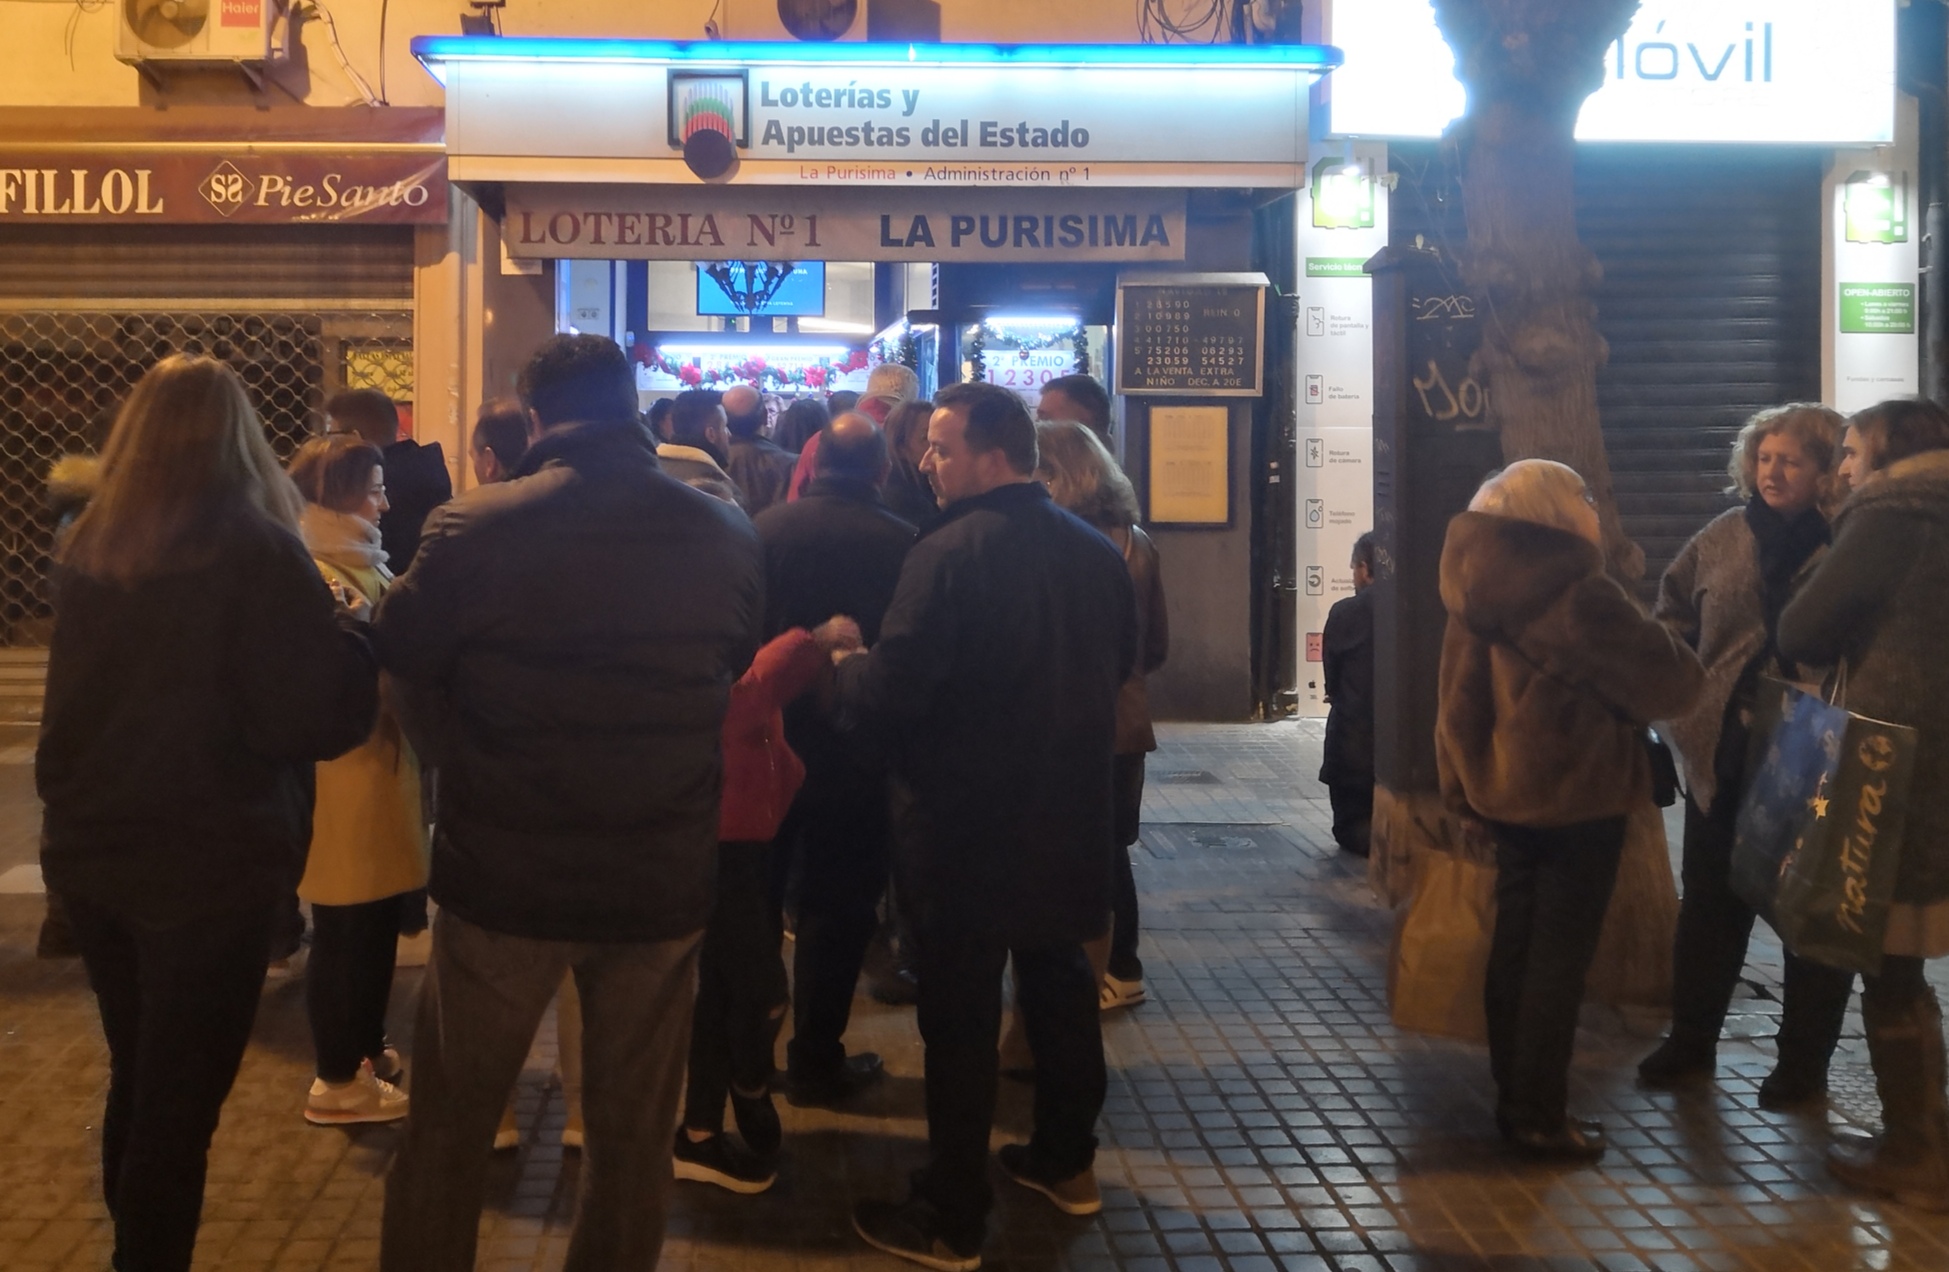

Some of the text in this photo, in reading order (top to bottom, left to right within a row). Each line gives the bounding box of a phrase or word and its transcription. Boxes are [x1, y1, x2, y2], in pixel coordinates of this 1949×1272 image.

[222, 1, 259, 14] Haier
[1616, 20, 1772, 82] óvil
[761, 80, 920, 117] Loterías y
[761, 119, 1090, 153] Apuestas del Estado
[800, 166, 819, 180] La
[827, 165, 896, 181] Purisima
[924, 166, 1050, 182] Administración
[1083, 167, 1090, 182] 1
[0, 169, 164, 214] FILLOL
[520, 211, 725, 247] LOTERIA
[880, 214, 1170, 248] LA PURISIMA
[1308, 262, 1363, 271] Servicio técn
[1844, 288, 1910, 297] OPEN-ABIERTO
[1147, 347, 1189, 355] 75206
[1202, 347, 1243, 355] 06293
[1012, 355, 1064, 367] PREMIO
[1147, 357, 1244, 365] 23059 54527
[1134, 367, 1142, 375] A
[1200, 367, 1234, 375] EXTRA
[1146, 376, 1175, 386] NIÑO
[1213, 378, 1220, 386] A
[1837, 779, 1887, 934] natura
